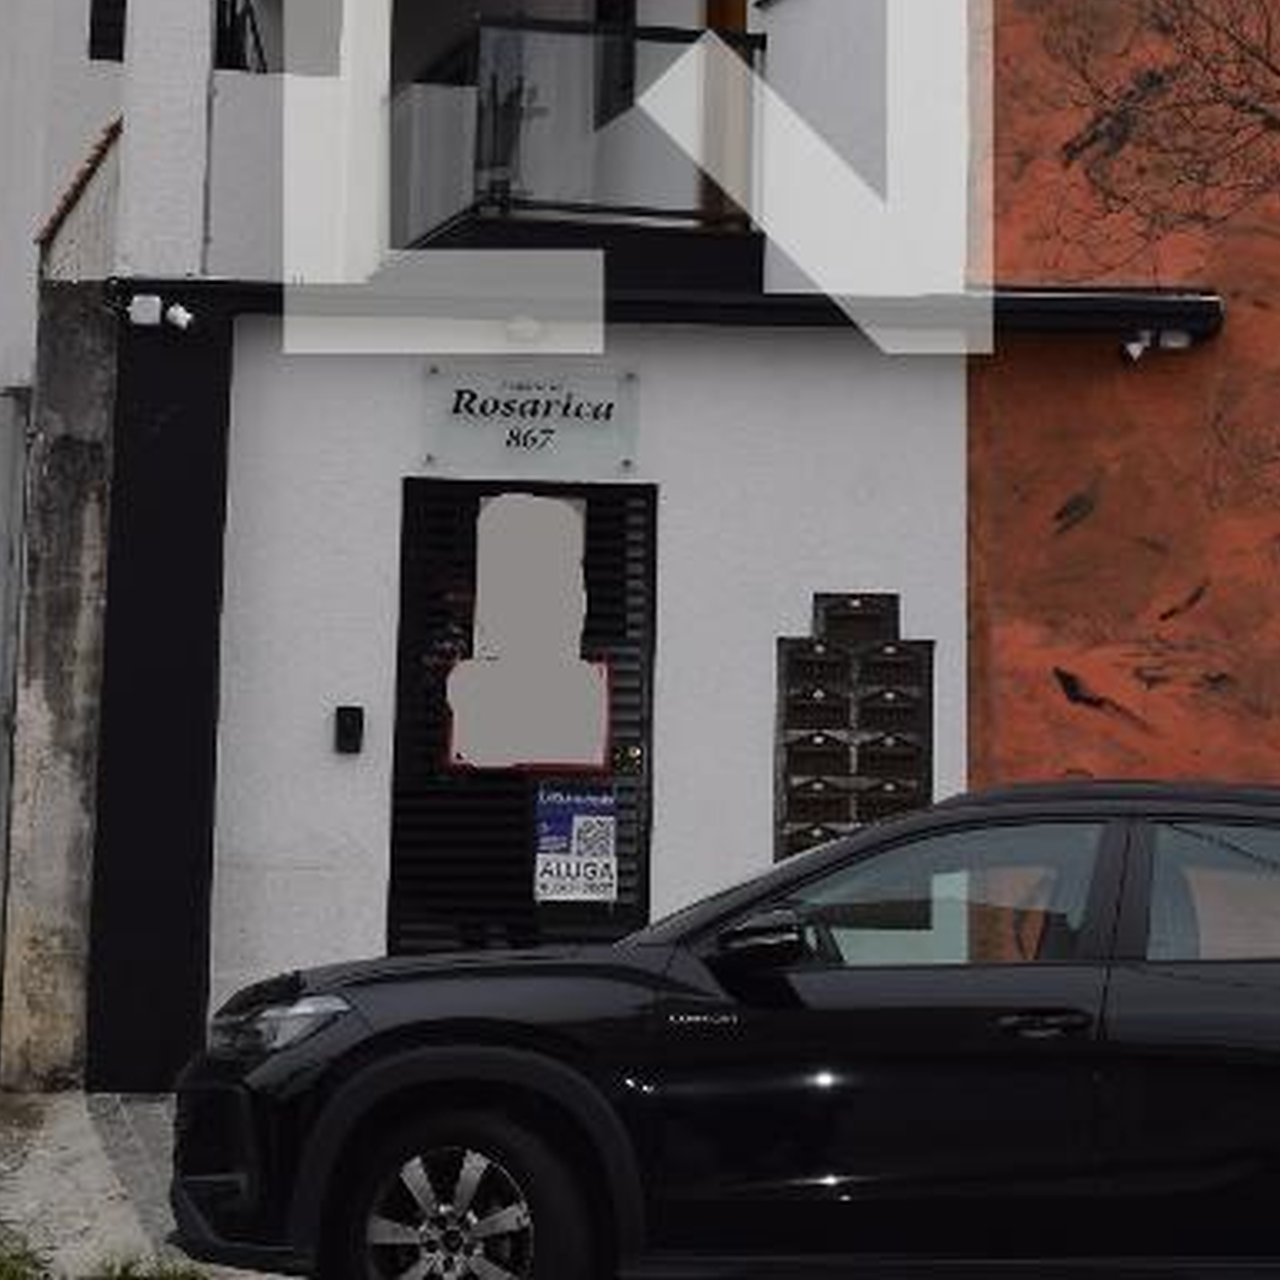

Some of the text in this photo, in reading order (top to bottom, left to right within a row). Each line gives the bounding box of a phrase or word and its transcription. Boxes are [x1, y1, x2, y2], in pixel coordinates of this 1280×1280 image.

[452, 388, 615, 422] Rosarica
[505, 426, 556, 451] 867
[540, 861, 614, 881] ALUGA
